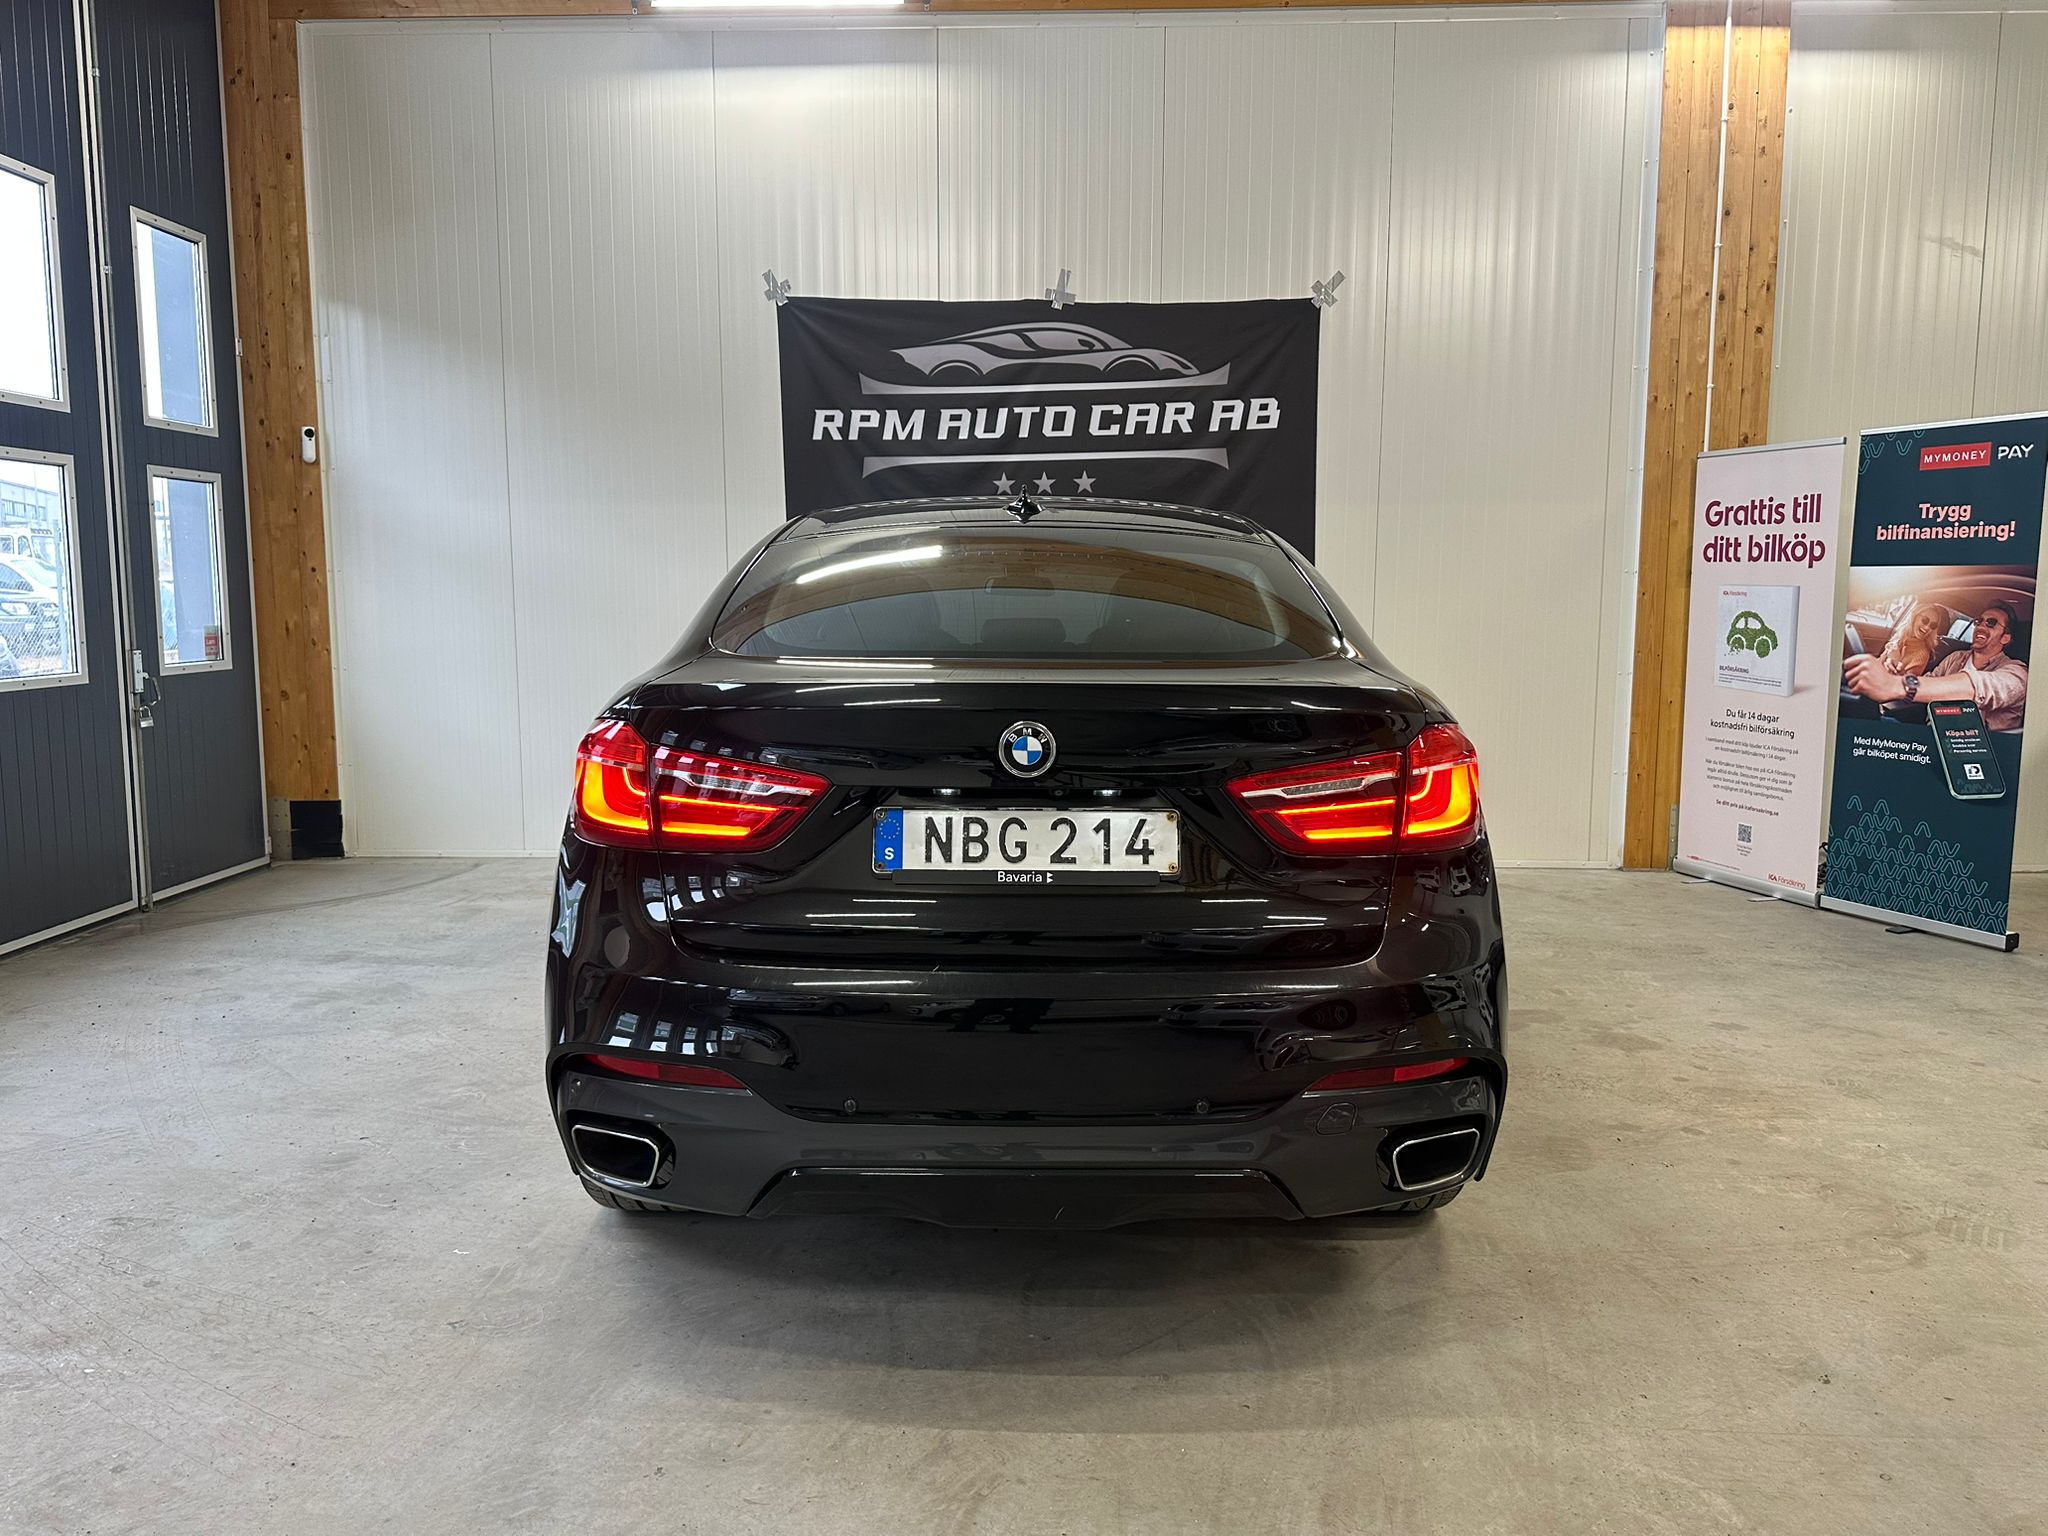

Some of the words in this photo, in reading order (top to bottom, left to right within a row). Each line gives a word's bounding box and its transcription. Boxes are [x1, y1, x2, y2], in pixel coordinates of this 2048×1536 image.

[812, 409, 926, 441] RPM
[937, 405, 1077, 440] AUTO
[1088, 401, 1195, 436] CAR
[1208, 397, 1281, 432] AB
[1923, 450, 1987, 464] MYMONEY
[1997, 443, 2034, 460] PAY
[1705, 496, 1786, 527] Grattis
[1792, 493, 1822, 524] till
[1918, 503, 1972, 522] Trygg
[1876, 520, 2016, 542] bilfinansiering!
[1703, 535, 1742, 562] ditt
[1748, 533, 1826, 569] bilköp
[1726, 708, 1736, 717] Du
[1737, 710, 1747, 719] får
[1748, 712, 1755, 720] 14
[1757, 713, 1779, 724] dagar
[1008, 727, 1048, 743] BMW
[1710, 719, 1748, 731] kostnadsfri
[1749, 723, 1795, 739] bilförsäkring
[1945, 729, 1964, 737] Köpa
[1853, 736, 1871, 745] Med
[1872, 738, 1911, 751] MyMoney
[1912, 742, 1927, 753] Pay
[1853, 747, 1866, 756] går
[1867, 748, 1898, 760] bilköpet
[1900, 753, 1932, 764] smidigt.
[924, 815, 1028, 864] NBG
[1049, 817, 1155, 865] 214
[884, 847, 895, 861] S
[997, 870, 1043, 883] Bavaria
[1768, 873, 1778, 881] ICA
[1778, 875, 1806, 890] Försäkring
